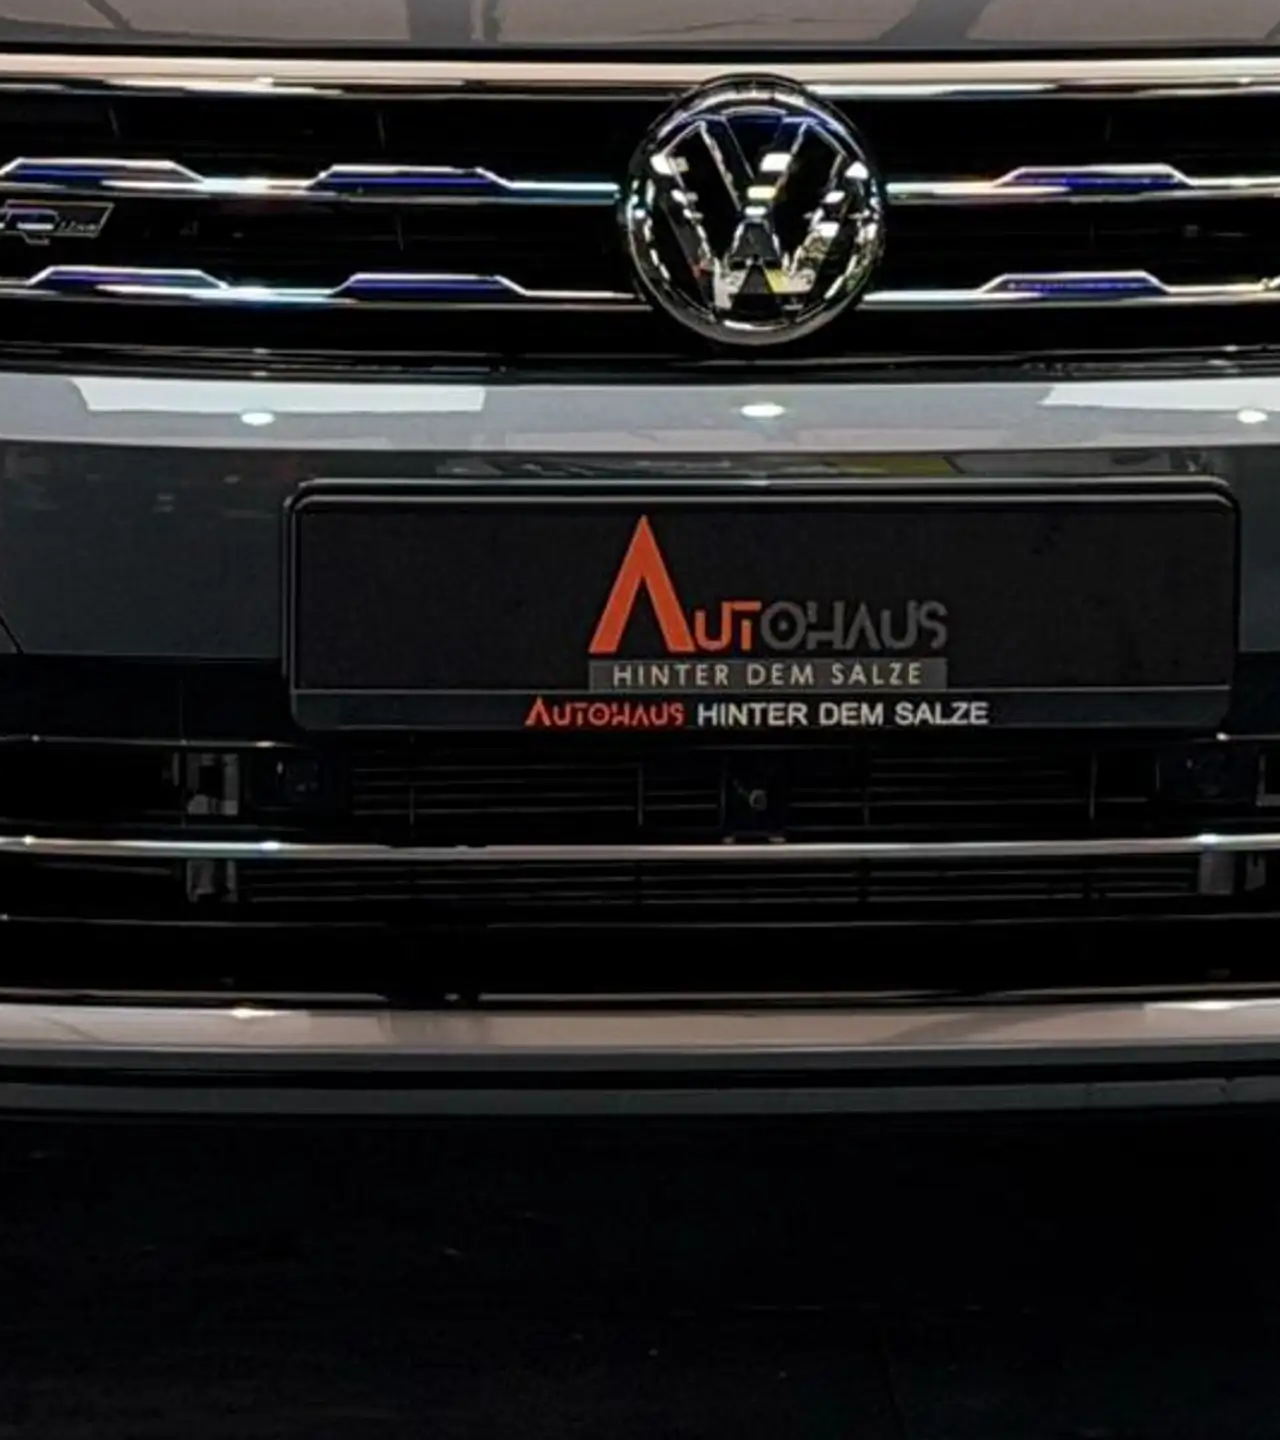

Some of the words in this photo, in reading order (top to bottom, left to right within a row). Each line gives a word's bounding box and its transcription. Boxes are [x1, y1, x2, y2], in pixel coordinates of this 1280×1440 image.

[588, 514, 949, 651] AUTOHAUS
[612, 662, 730, 687] HINTER
[746, 662, 815, 687] DEM
[830, 662, 923, 687] SALZE
[524, 696, 685, 727] AUTOHAUS
[697, 702, 809, 727] HINTER
[819, 701, 885, 727] DEM
[894, 701, 991, 727] SALZE
